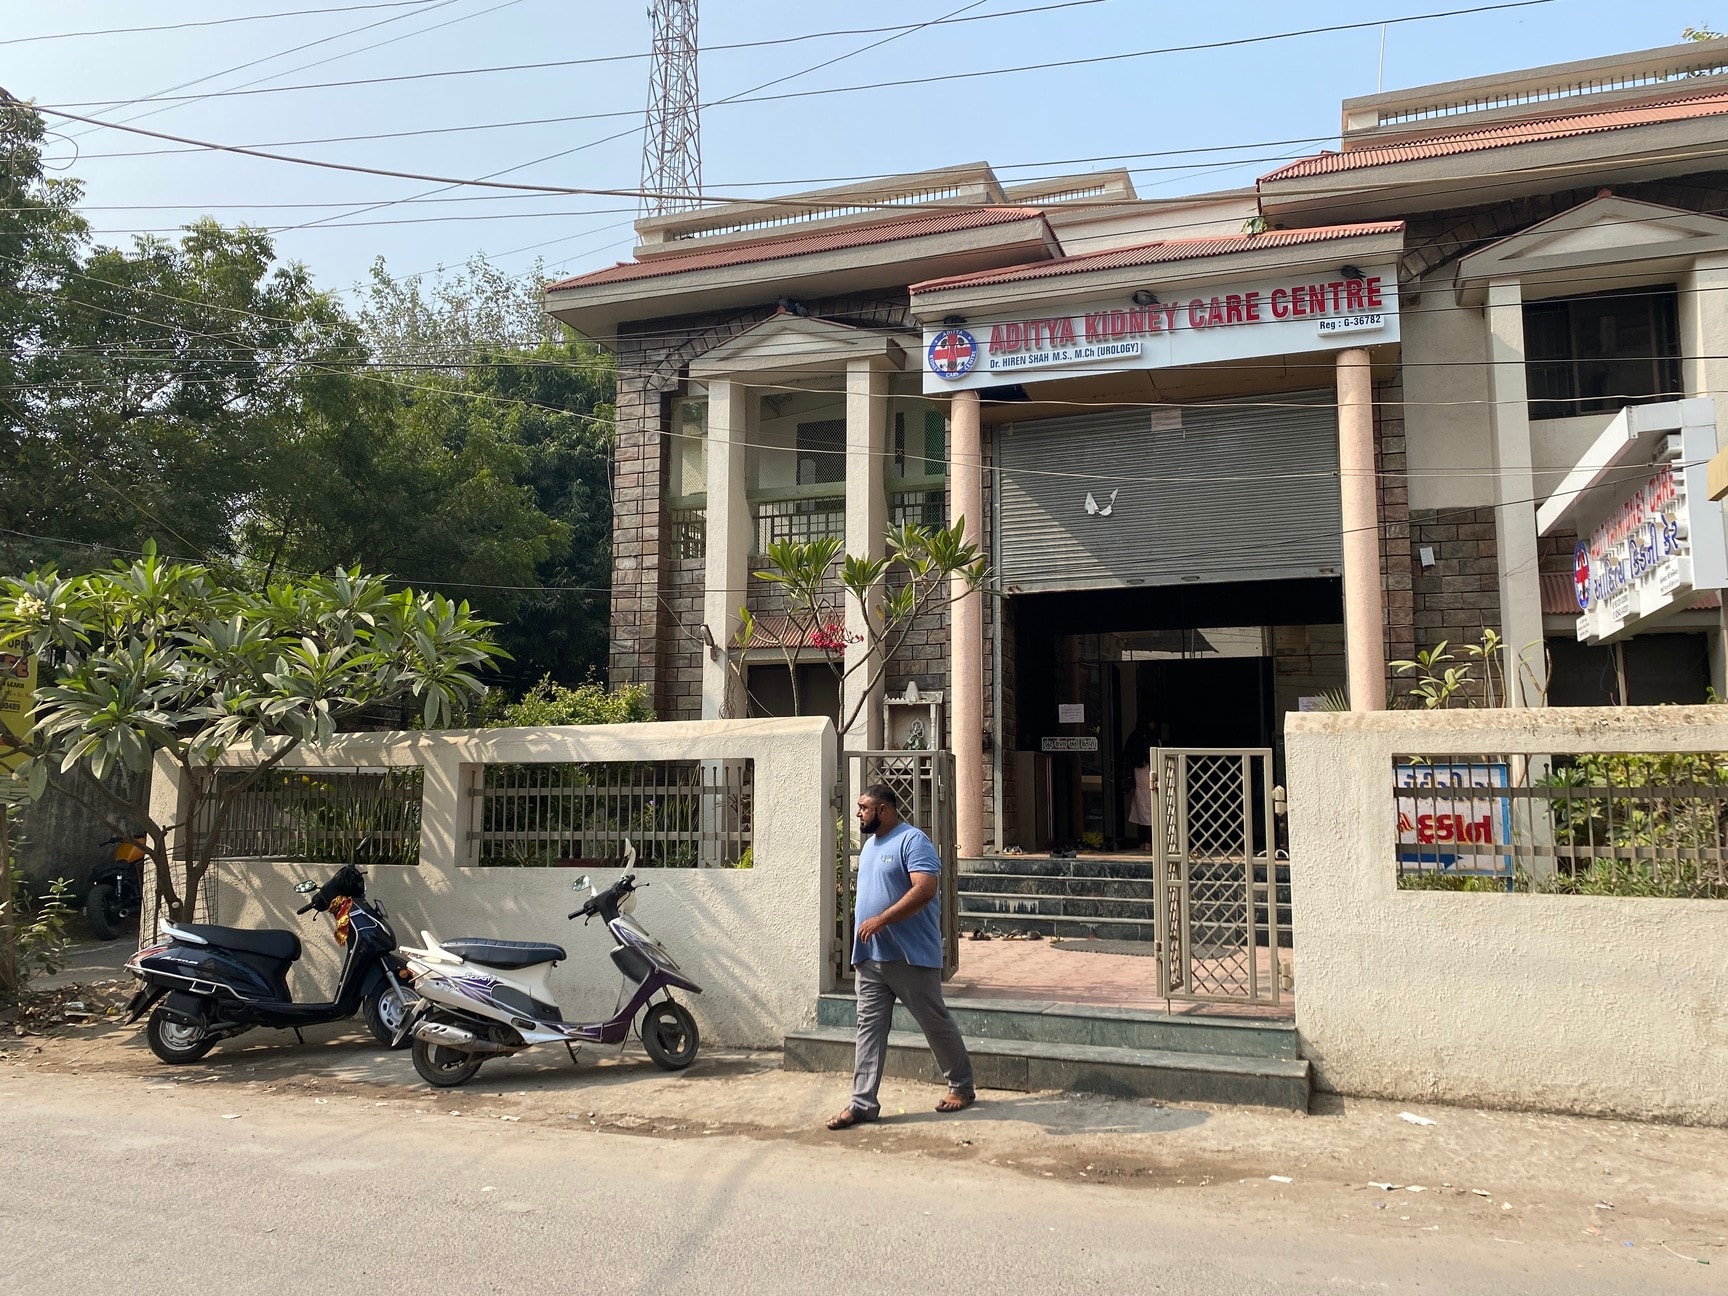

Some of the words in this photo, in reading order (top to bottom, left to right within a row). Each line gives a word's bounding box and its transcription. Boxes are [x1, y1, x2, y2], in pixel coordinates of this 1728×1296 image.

[989, 318, 1075, 354] ADITYA
[1084, 302, 1179, 342] KIDNEY
[1188, 291, 1260, 329] CARE
[1271, 277, 1382, 318] CENTRE
[1319, 321, 1336, 331] Reg
[1344, 315, 1381, 327] G-36782
[990, 358, 1000, 369] Dr.
[1002, 355, 1027, 367] HIREN
[1028, 352, 1049, 364] SHAH
